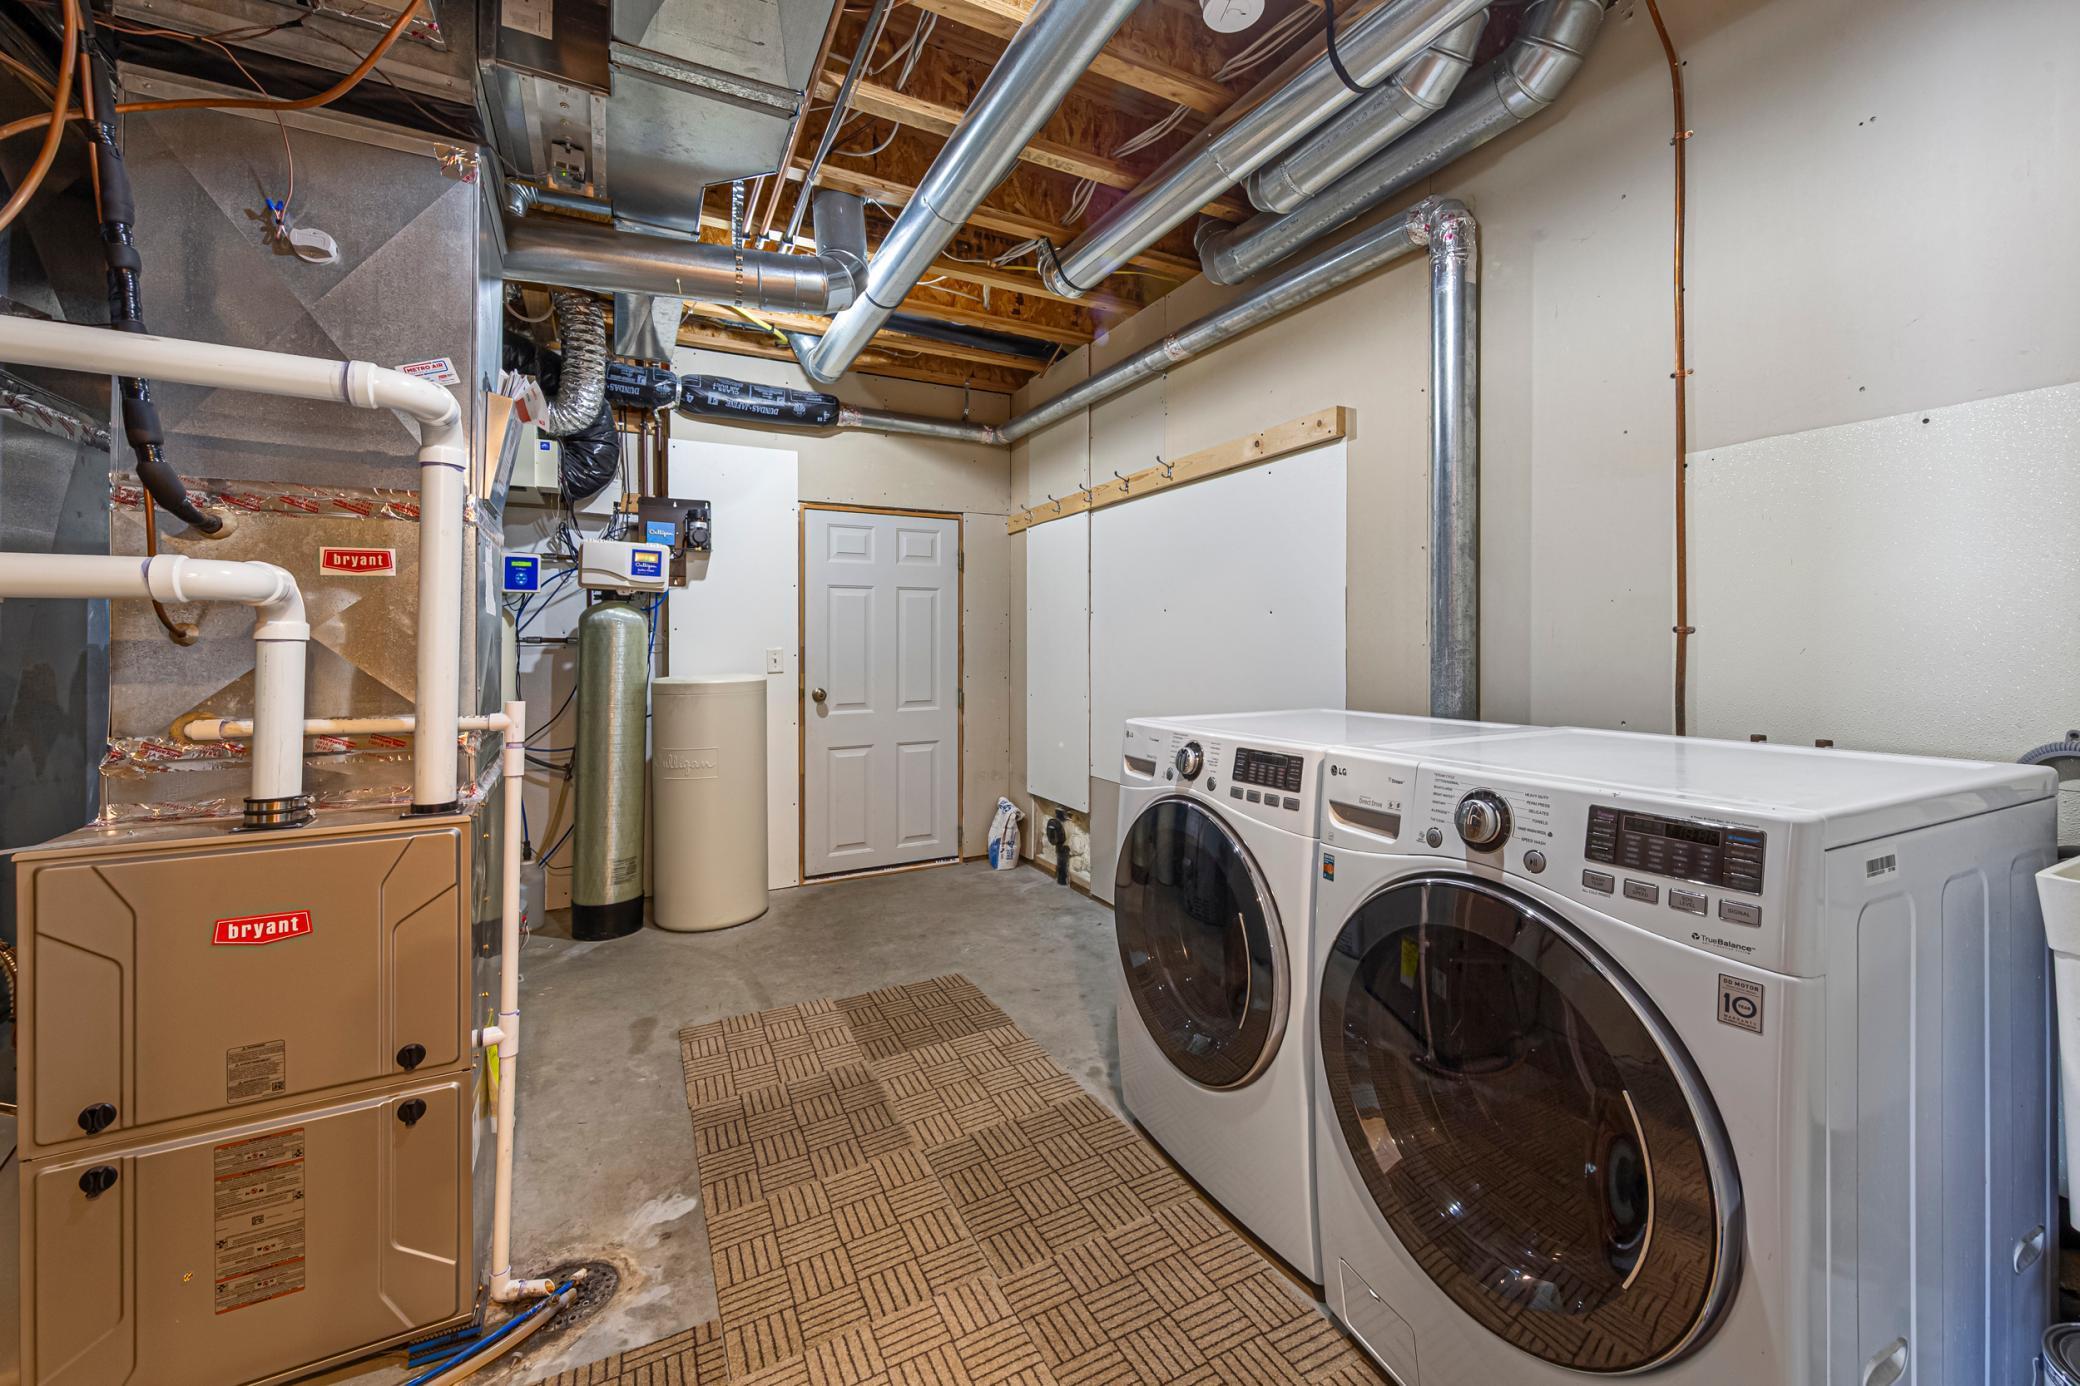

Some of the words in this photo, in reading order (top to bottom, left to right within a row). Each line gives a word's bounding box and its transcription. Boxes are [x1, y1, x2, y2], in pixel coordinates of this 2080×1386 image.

[406, 365, 431, 373] METRO
[649, 529, 674, 537] Culligan
[333, 552, 383, 569] bryant
[1338, 767, 1347, 776] LG
[1727, 908, 1750, 917] SIGNAL
[228, 916, 299, 940] bryant
[1734, 981, 1760, 993] MOTOR
[1723, 992, 1757, 1019] 10
[1737, 1003, 1751, 1011] YEAR
